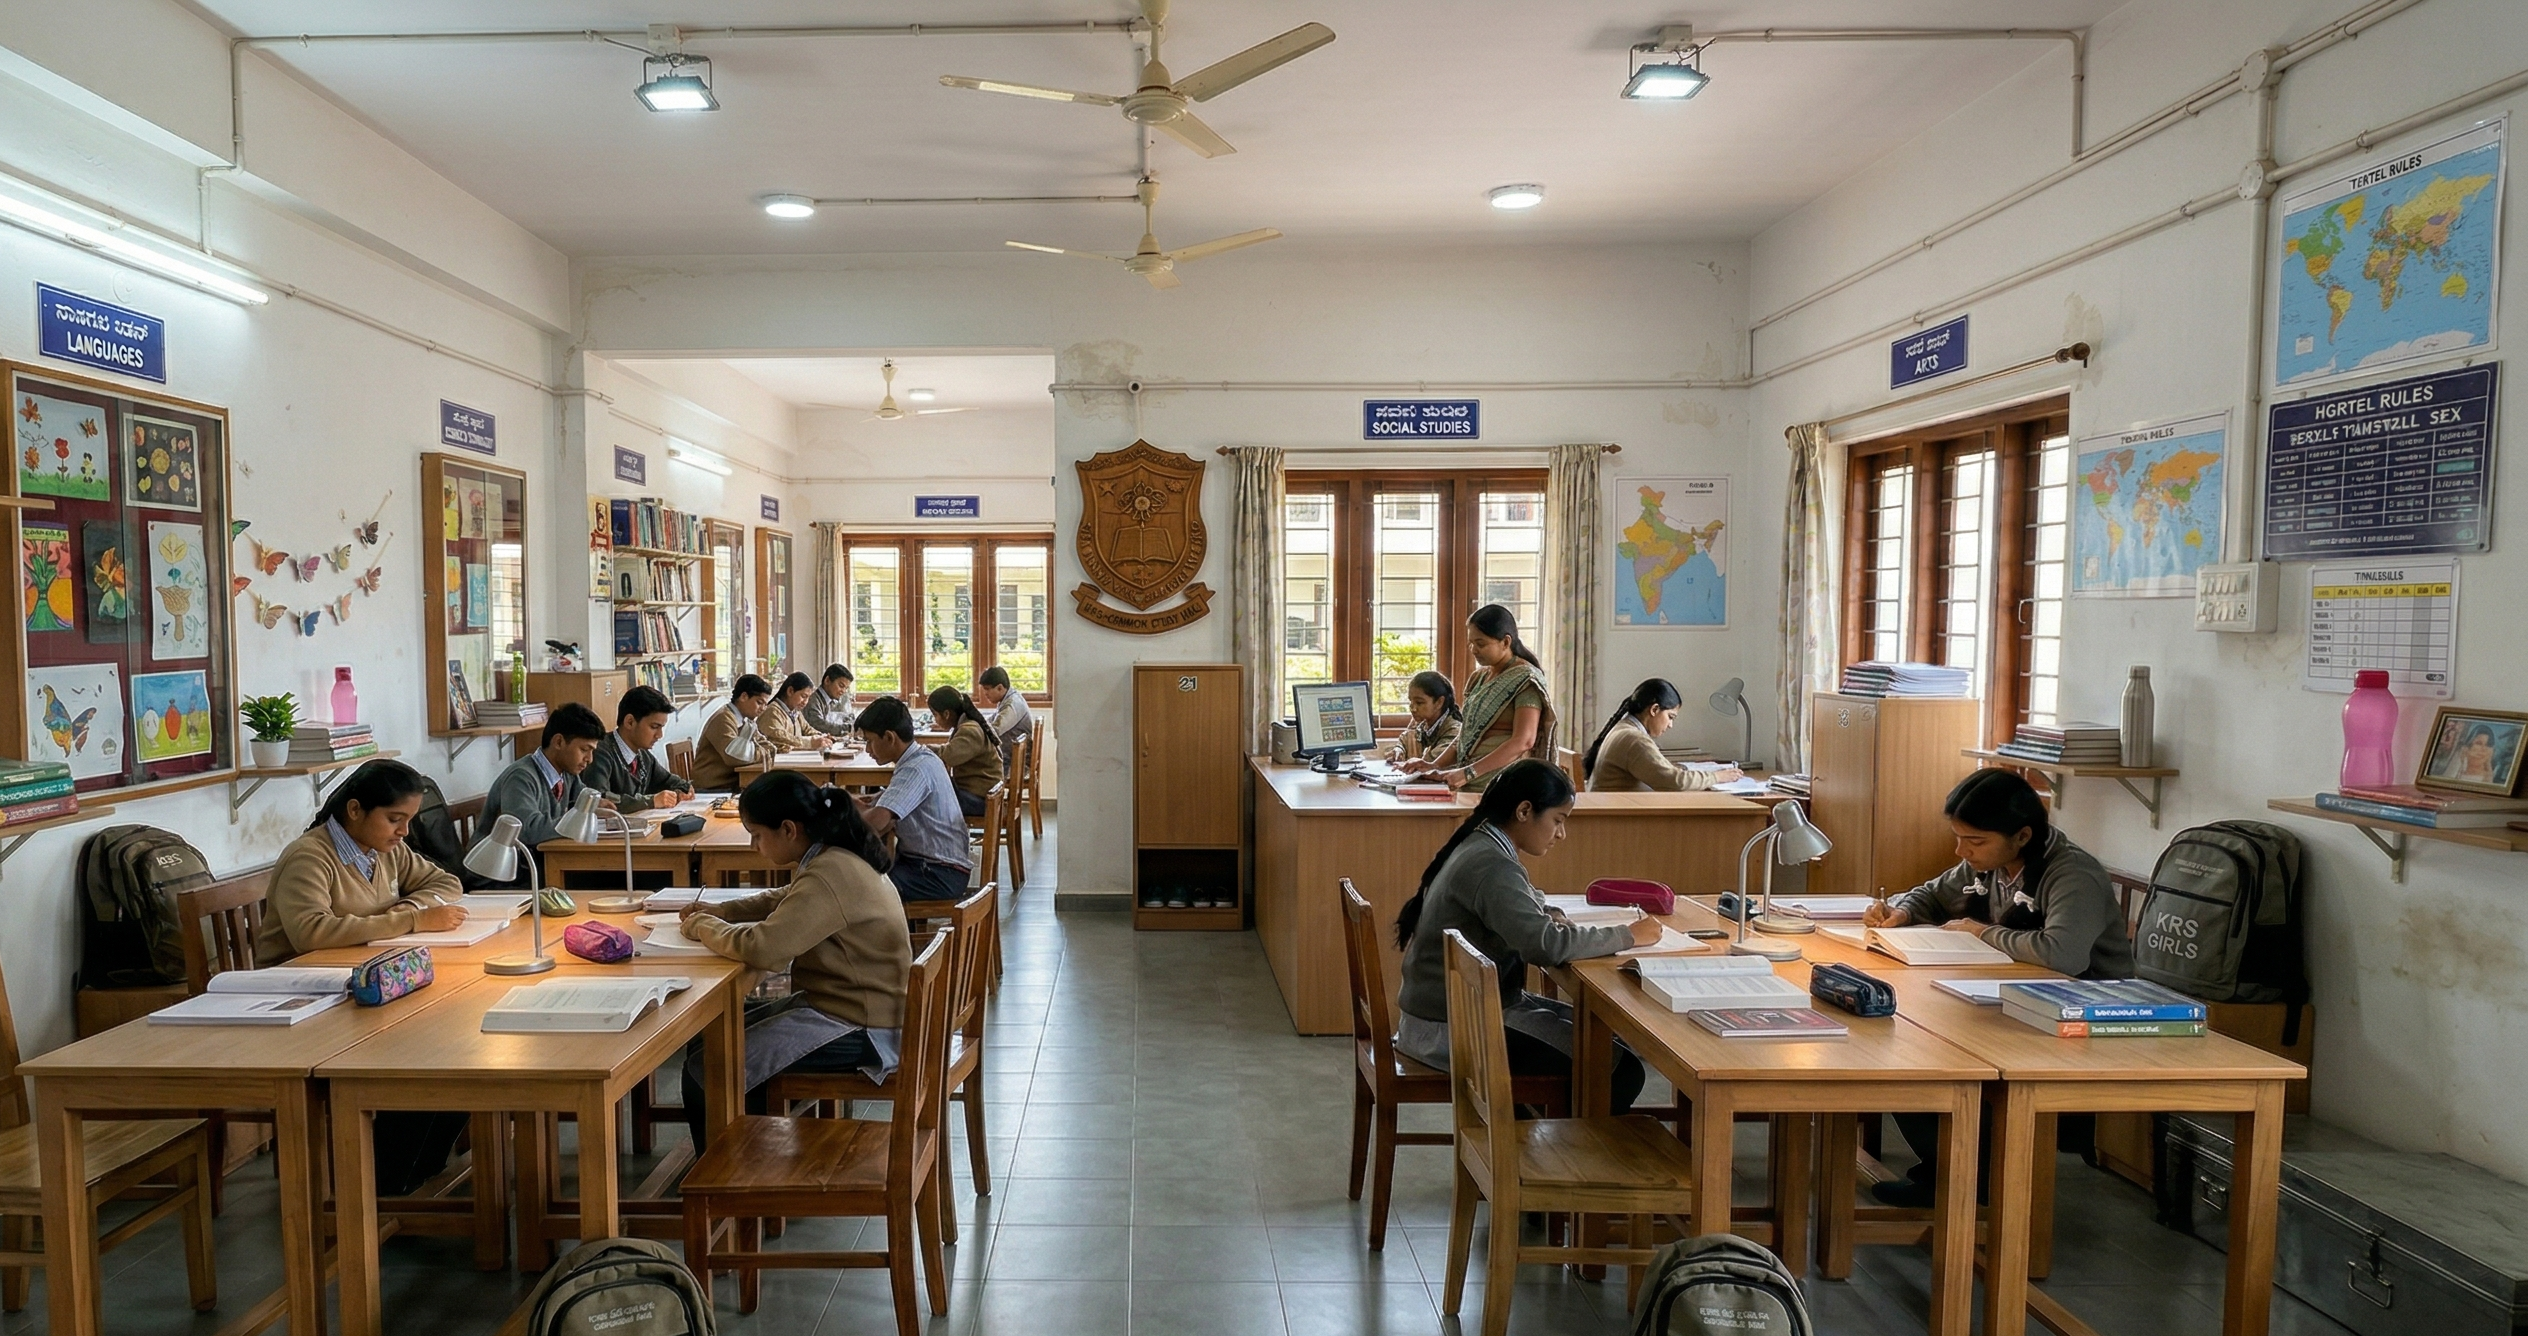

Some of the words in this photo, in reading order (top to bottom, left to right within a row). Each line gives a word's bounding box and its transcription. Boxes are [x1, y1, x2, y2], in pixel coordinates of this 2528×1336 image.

[2389, 154, 2422, 177] RULES
[67, 331, 144, 368] LANGUAGES
[1914, 354, 1939, 375] ARTS
[2380, 385, 2434, 409] RULES
[1372, 421, 1417, 434] SOCIAL
[1419, 420, 1471, 434] STUDIES
[2429, 406, 2463, 426] SEX
[1178, 675, 1198, 692] 21
[2156, 911, 2199, 939] KRS
[2147, 933, 2199, 959] GIRLS
